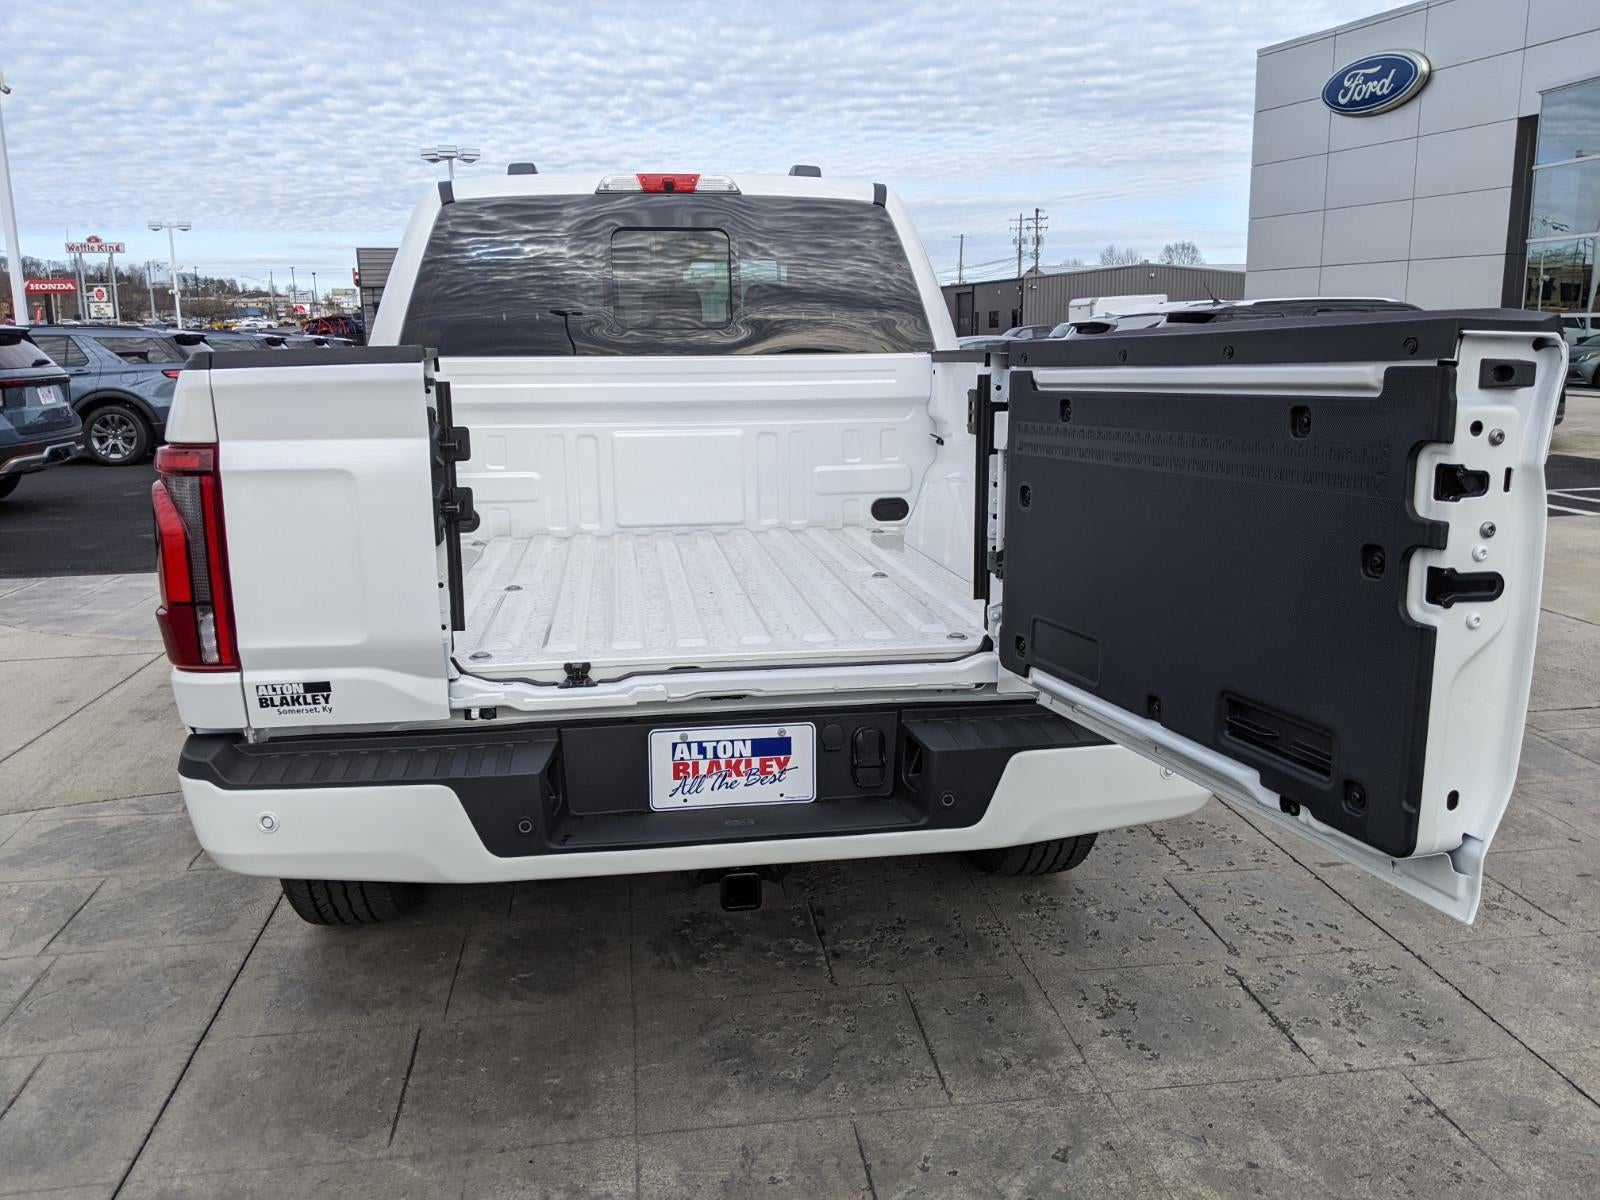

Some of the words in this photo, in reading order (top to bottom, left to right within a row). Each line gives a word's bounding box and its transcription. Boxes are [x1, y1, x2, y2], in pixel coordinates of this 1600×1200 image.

[1338, 65, 1396, 104] Ford
[67, 243, 95, 252] Waffle
[259, 684, 304, 695] ALTON
[259, 694, 330, 708] BLAKLEY
[673, 741, 752, 760] ALTON
[672, 756, 791, 781] BLAKLEY
[669, 773, 708, 797] All
[709, 769, 740, 792] The
[743, 766, 798, 787] Best
